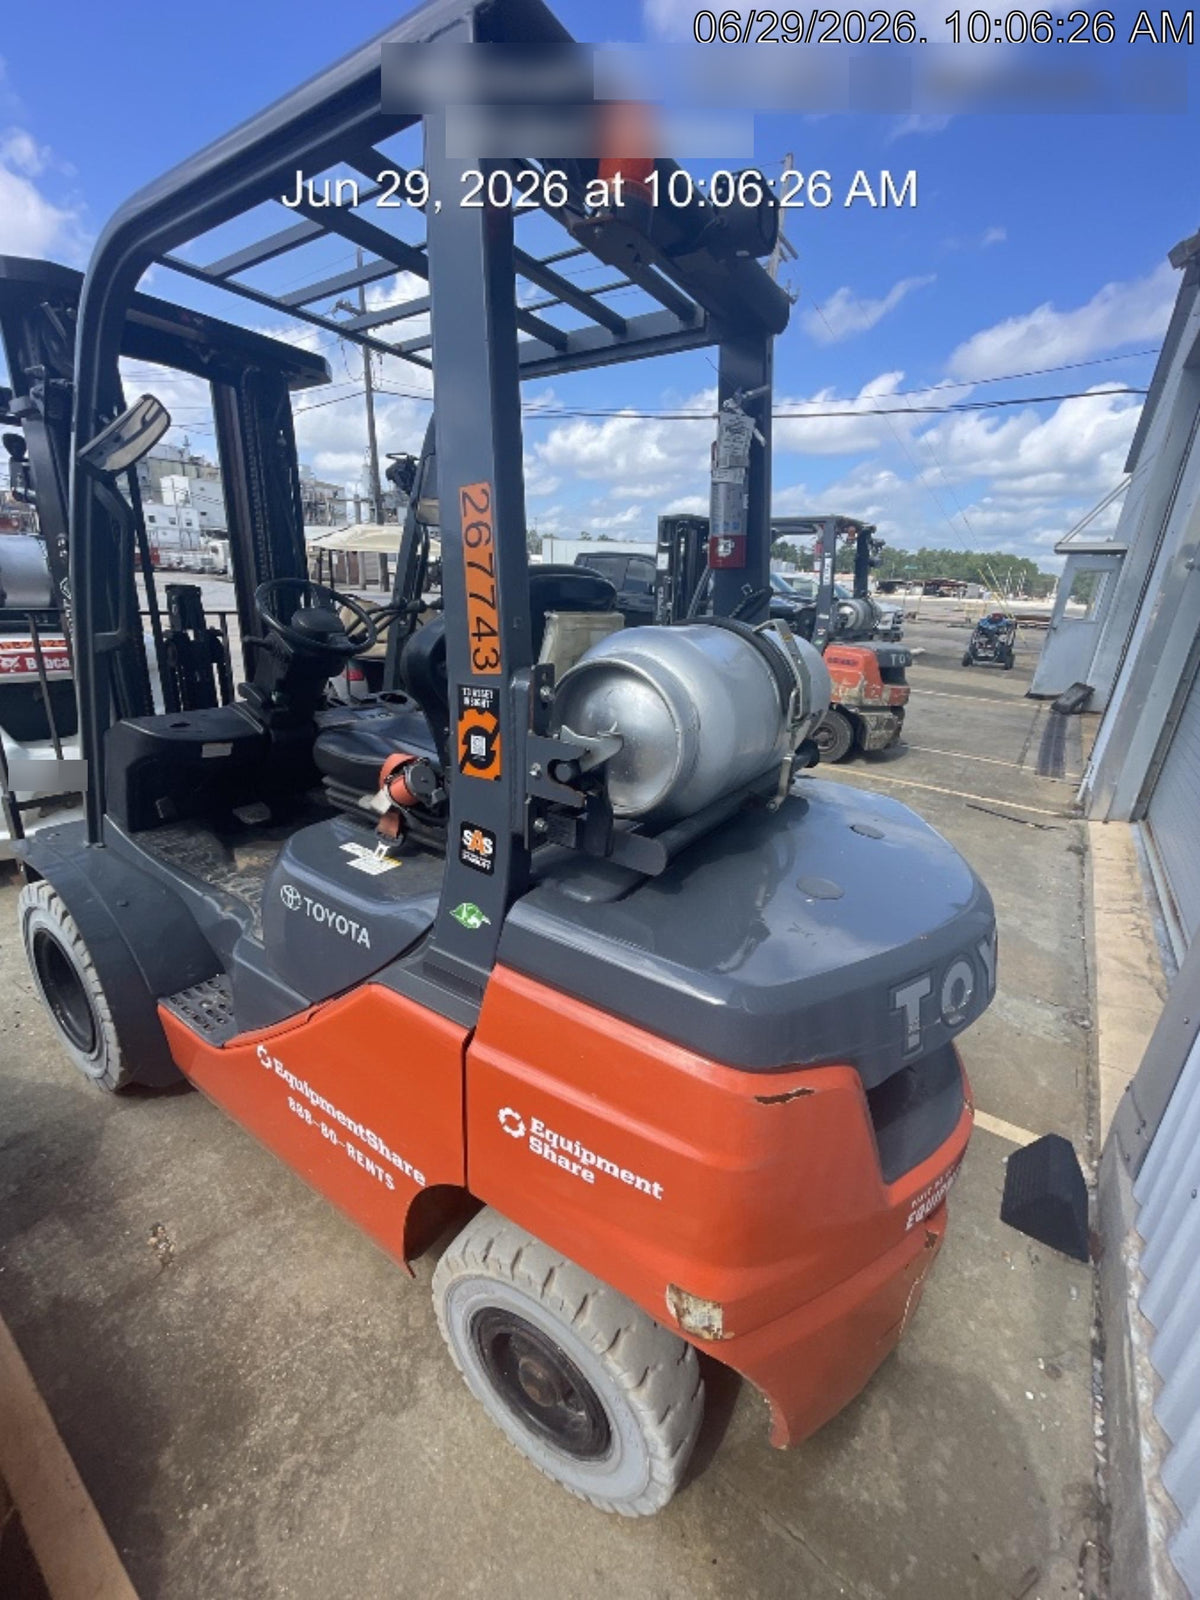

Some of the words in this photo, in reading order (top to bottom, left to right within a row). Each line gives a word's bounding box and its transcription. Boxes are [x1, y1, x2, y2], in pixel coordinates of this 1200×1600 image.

[462, 487, 500, 671] 2677743
[461, 829, 494, 855] SAS
[303, 897, 371, 949] TOYOTA
[272, 1057, 427, 1188] EquipmentShare
[528, 1135, 596, 1185] Share
[529, 1115, 665, 1201] Equipment
